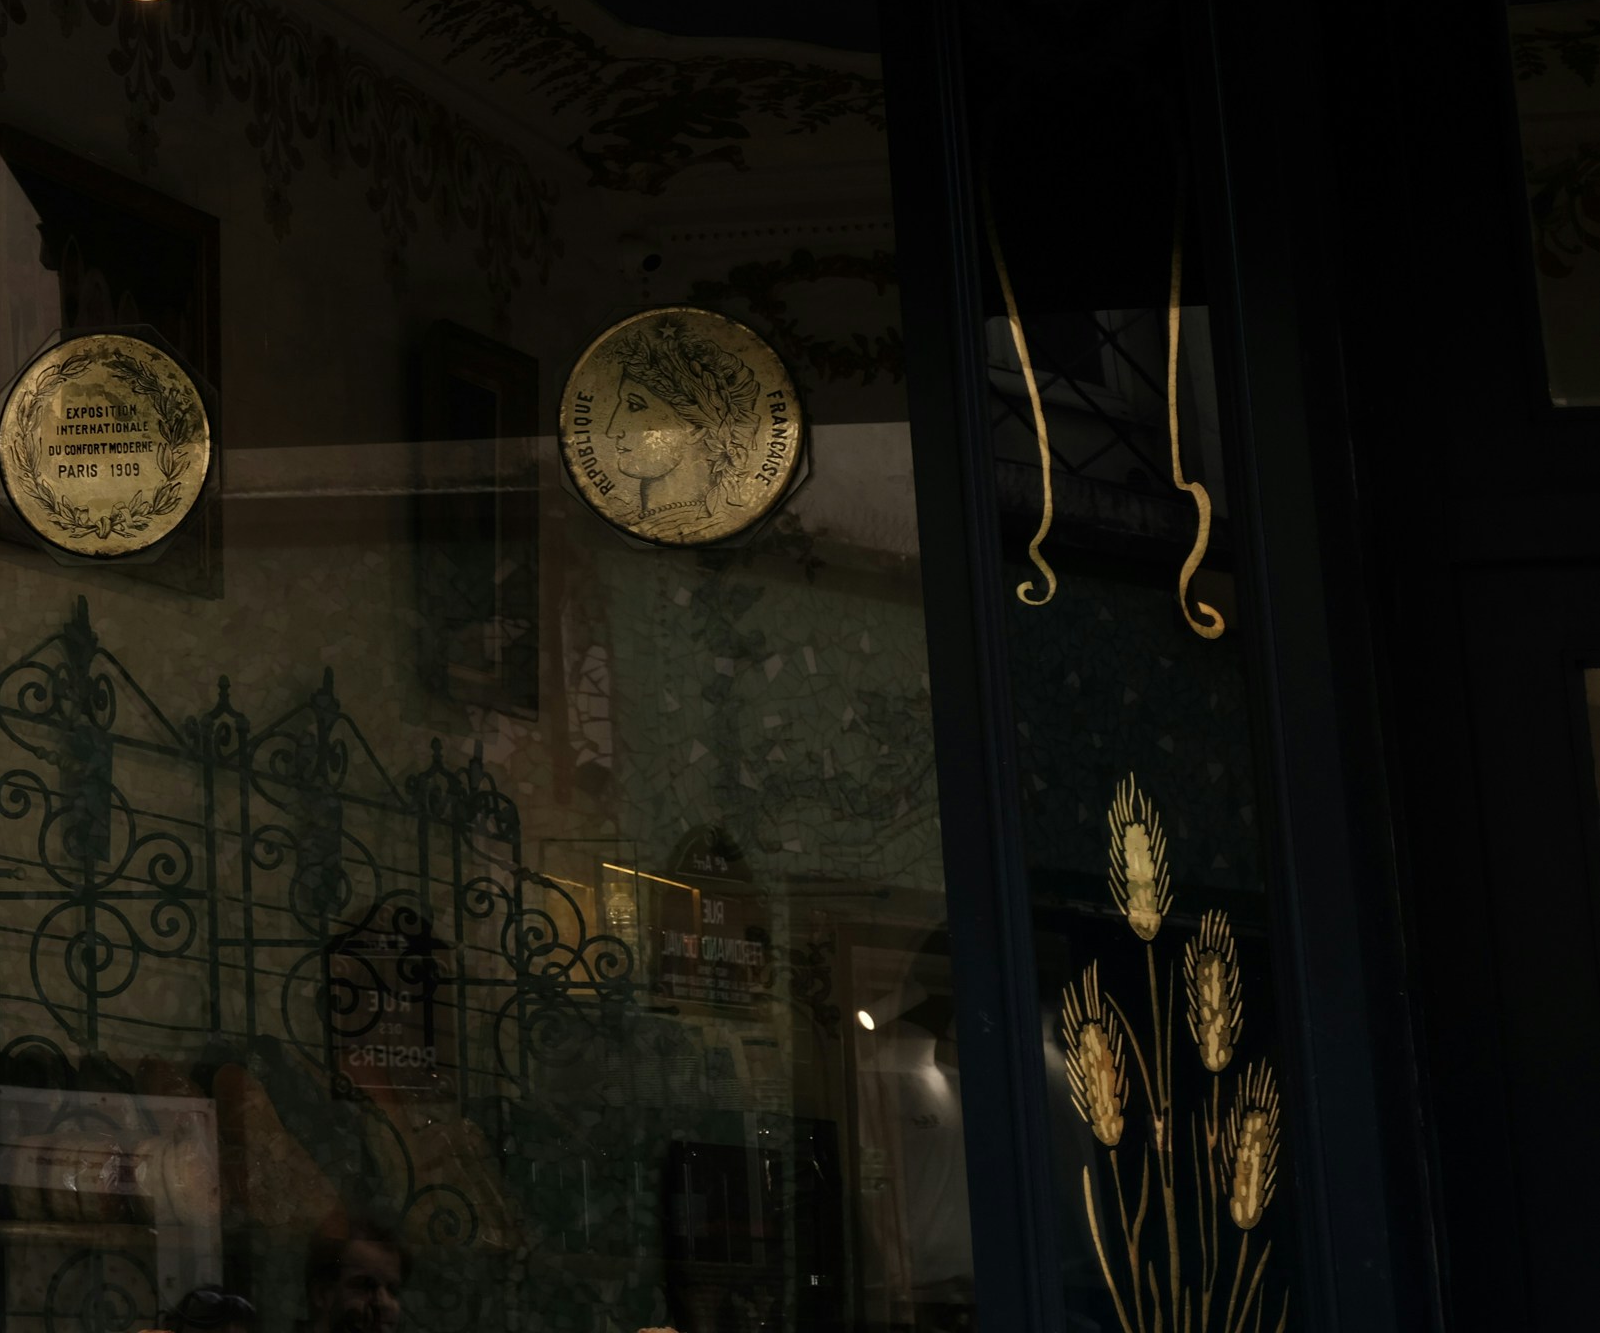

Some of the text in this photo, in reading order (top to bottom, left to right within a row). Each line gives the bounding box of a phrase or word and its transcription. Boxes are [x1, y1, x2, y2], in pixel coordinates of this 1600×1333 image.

[66, 404, 137, 420] EXPOSITION
[56, 421, 149, 435] INTERNATIONALE
[754, 389, 788, 487] FRANÇAISE
[48, 441, 153, 456] DU CONFORT MODERNE
[58, 462, 140, 478] PARIS 1909
